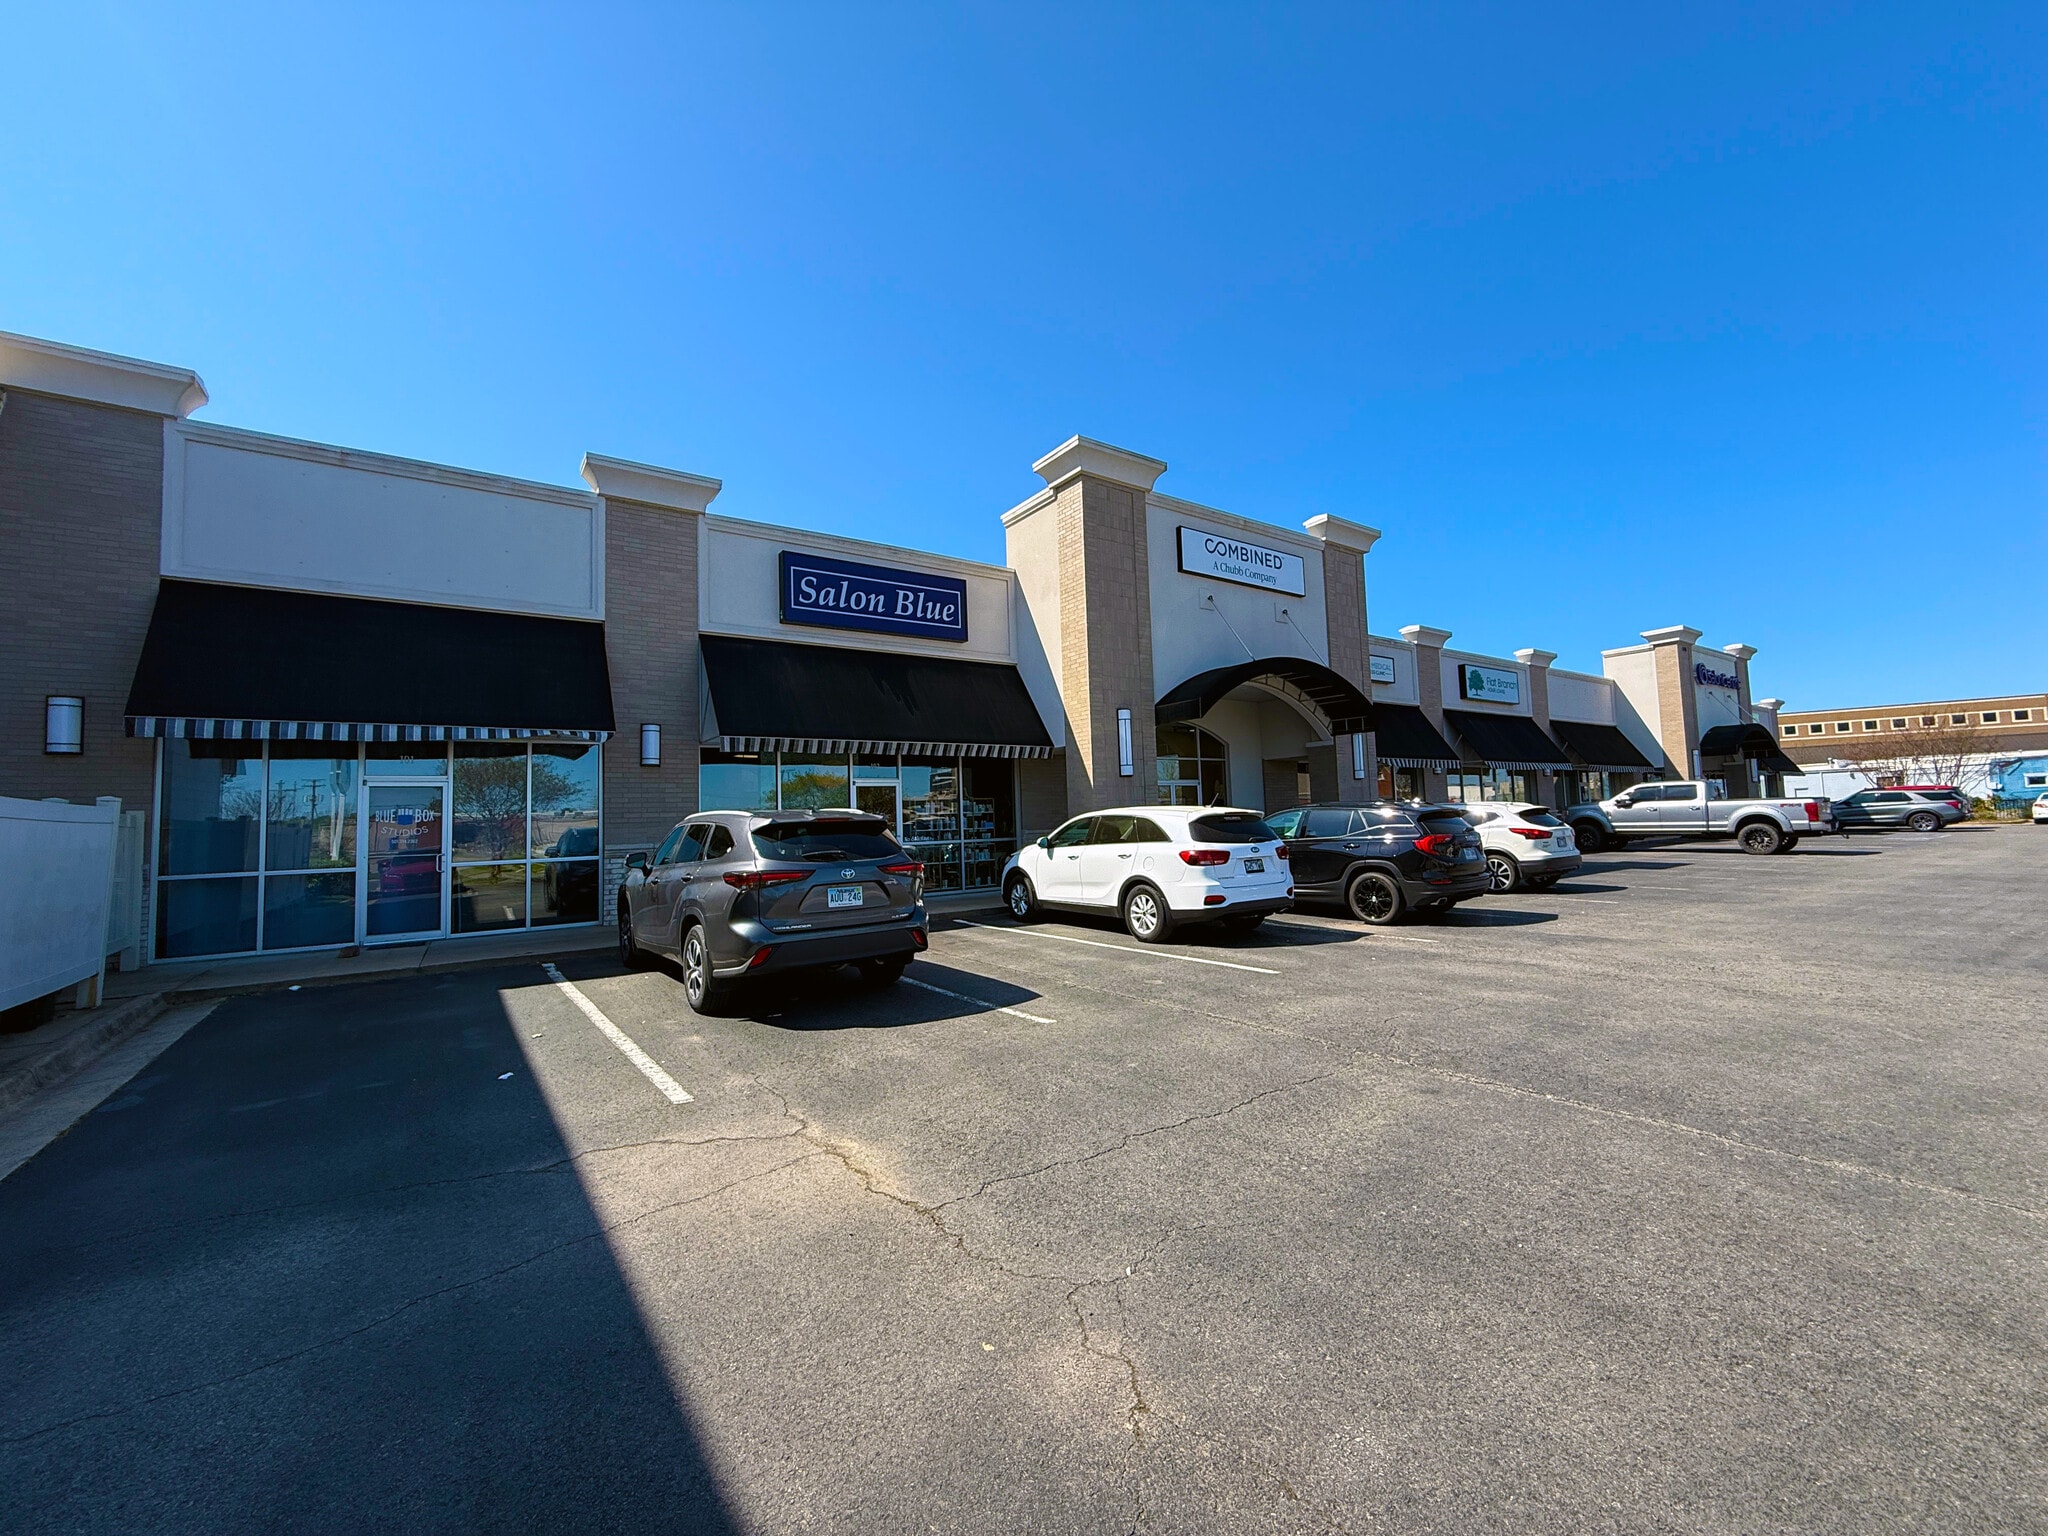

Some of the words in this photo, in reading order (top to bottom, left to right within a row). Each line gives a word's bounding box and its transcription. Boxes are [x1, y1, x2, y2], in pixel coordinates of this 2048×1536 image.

[1204, 538, 1283, 570] COMBINED
[1213, 561, 1219, 571] A
[1220, 562, 1244, 577] Chubb
[1245, 568, 1277, 585] Company
[798, 576, 886, 613] Salon
[894, 589, 956, 622] Blue
[1486, 677, 1497, 687] Flat
[1498, 678, 1517, 690] Branch
[400, 755, 414, 764] 101
[375, 809, 396, 824] BLUE
[415, 808, 435, 823] BOX
[380, 825, 429, 837] STUDIOS
